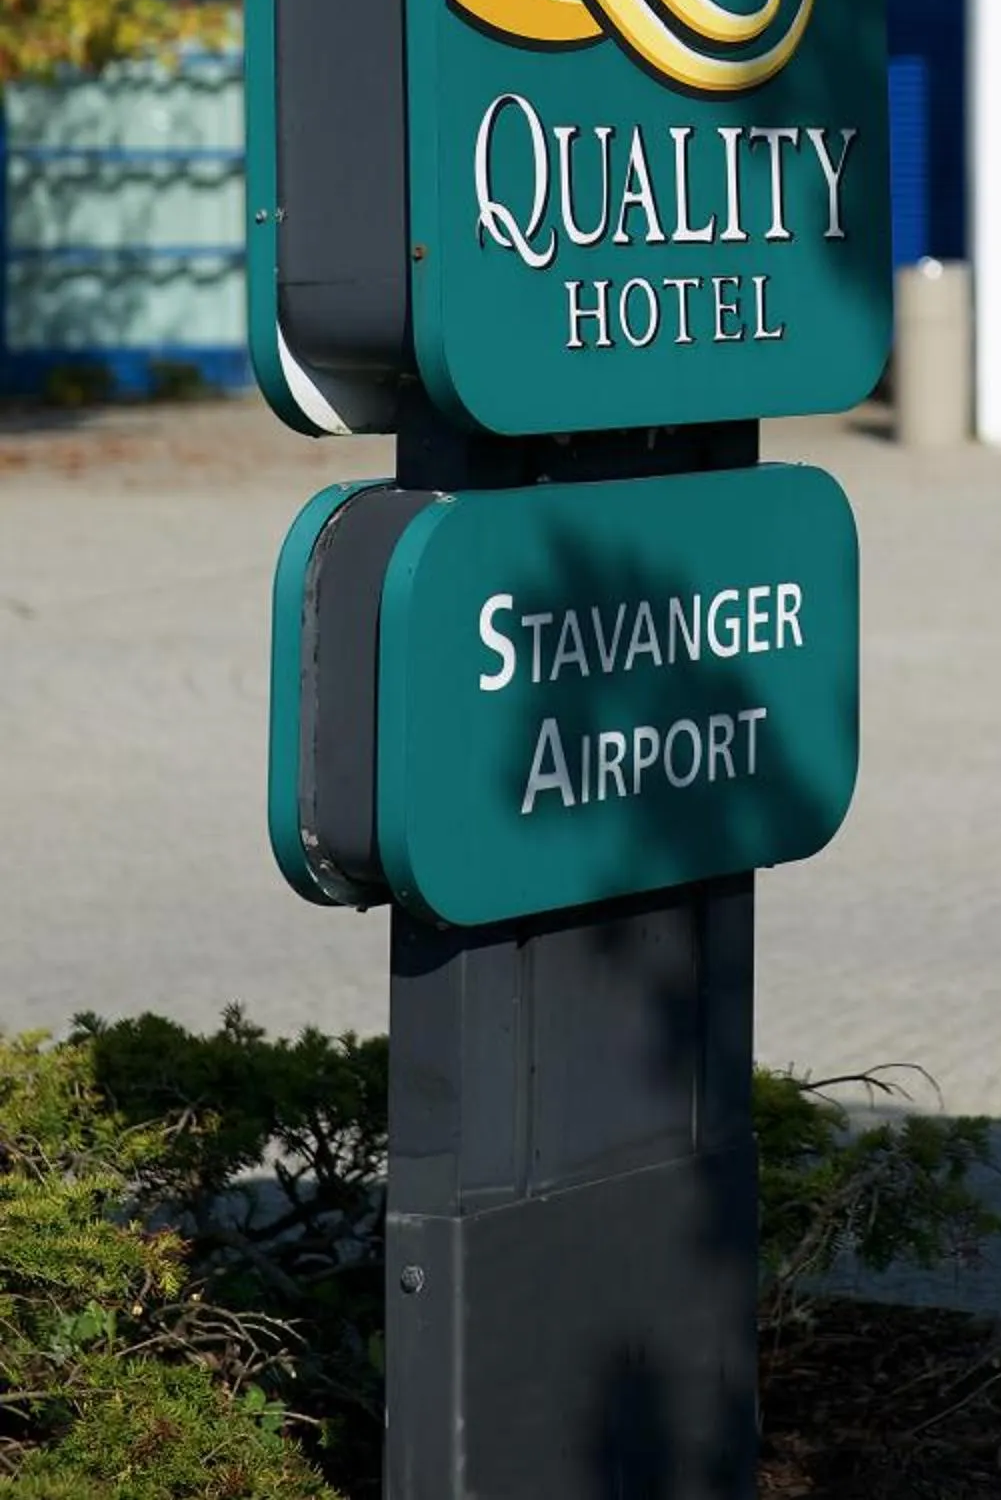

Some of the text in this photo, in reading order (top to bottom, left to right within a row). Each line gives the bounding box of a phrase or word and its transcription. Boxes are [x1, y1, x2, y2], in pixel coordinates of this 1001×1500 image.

[474, 92, 857, 269] QUALITY
[565, 274, 784, 348] HOTEL
[478, 583, 804, 691] STAVANGER
[520, 708, 767, 815] AIRPORT
